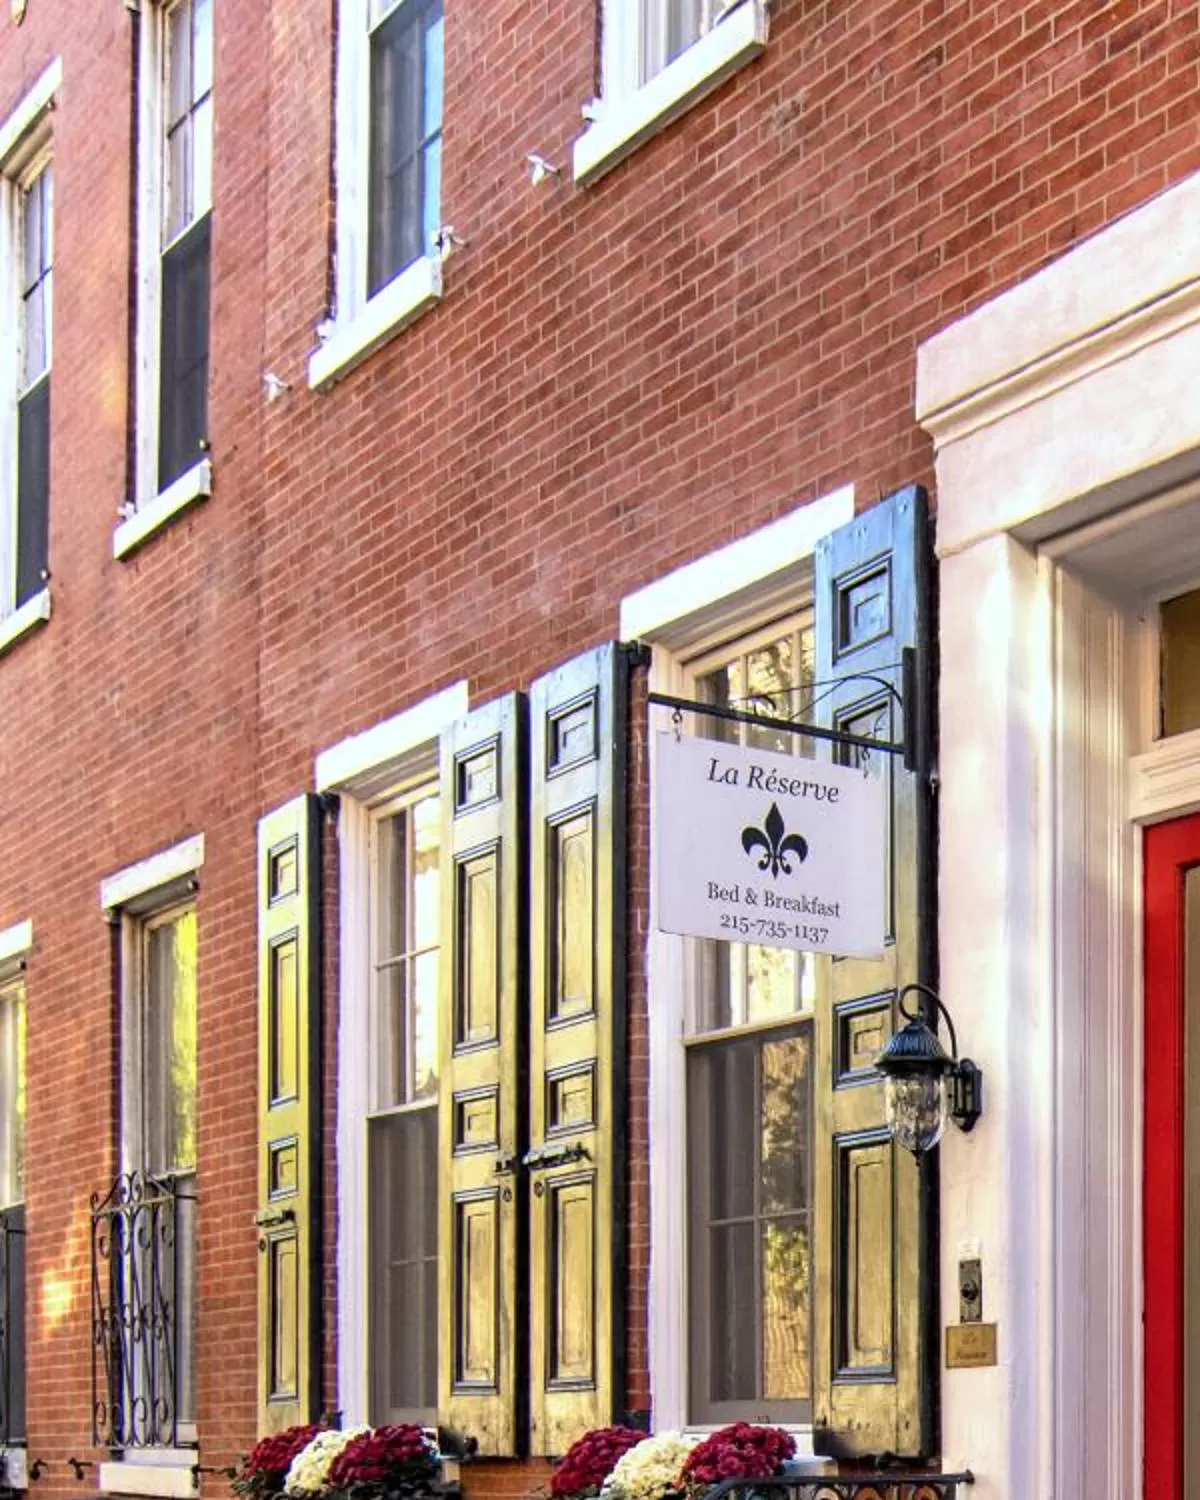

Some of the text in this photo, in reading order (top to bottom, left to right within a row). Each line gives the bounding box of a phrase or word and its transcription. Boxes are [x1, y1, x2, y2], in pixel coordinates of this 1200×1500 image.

[706, 757, 840, 803] La Réserve
[706, 881, 842, 919] Bed & Breakfast
[719, 914, 830, 946] 215-735-1137
